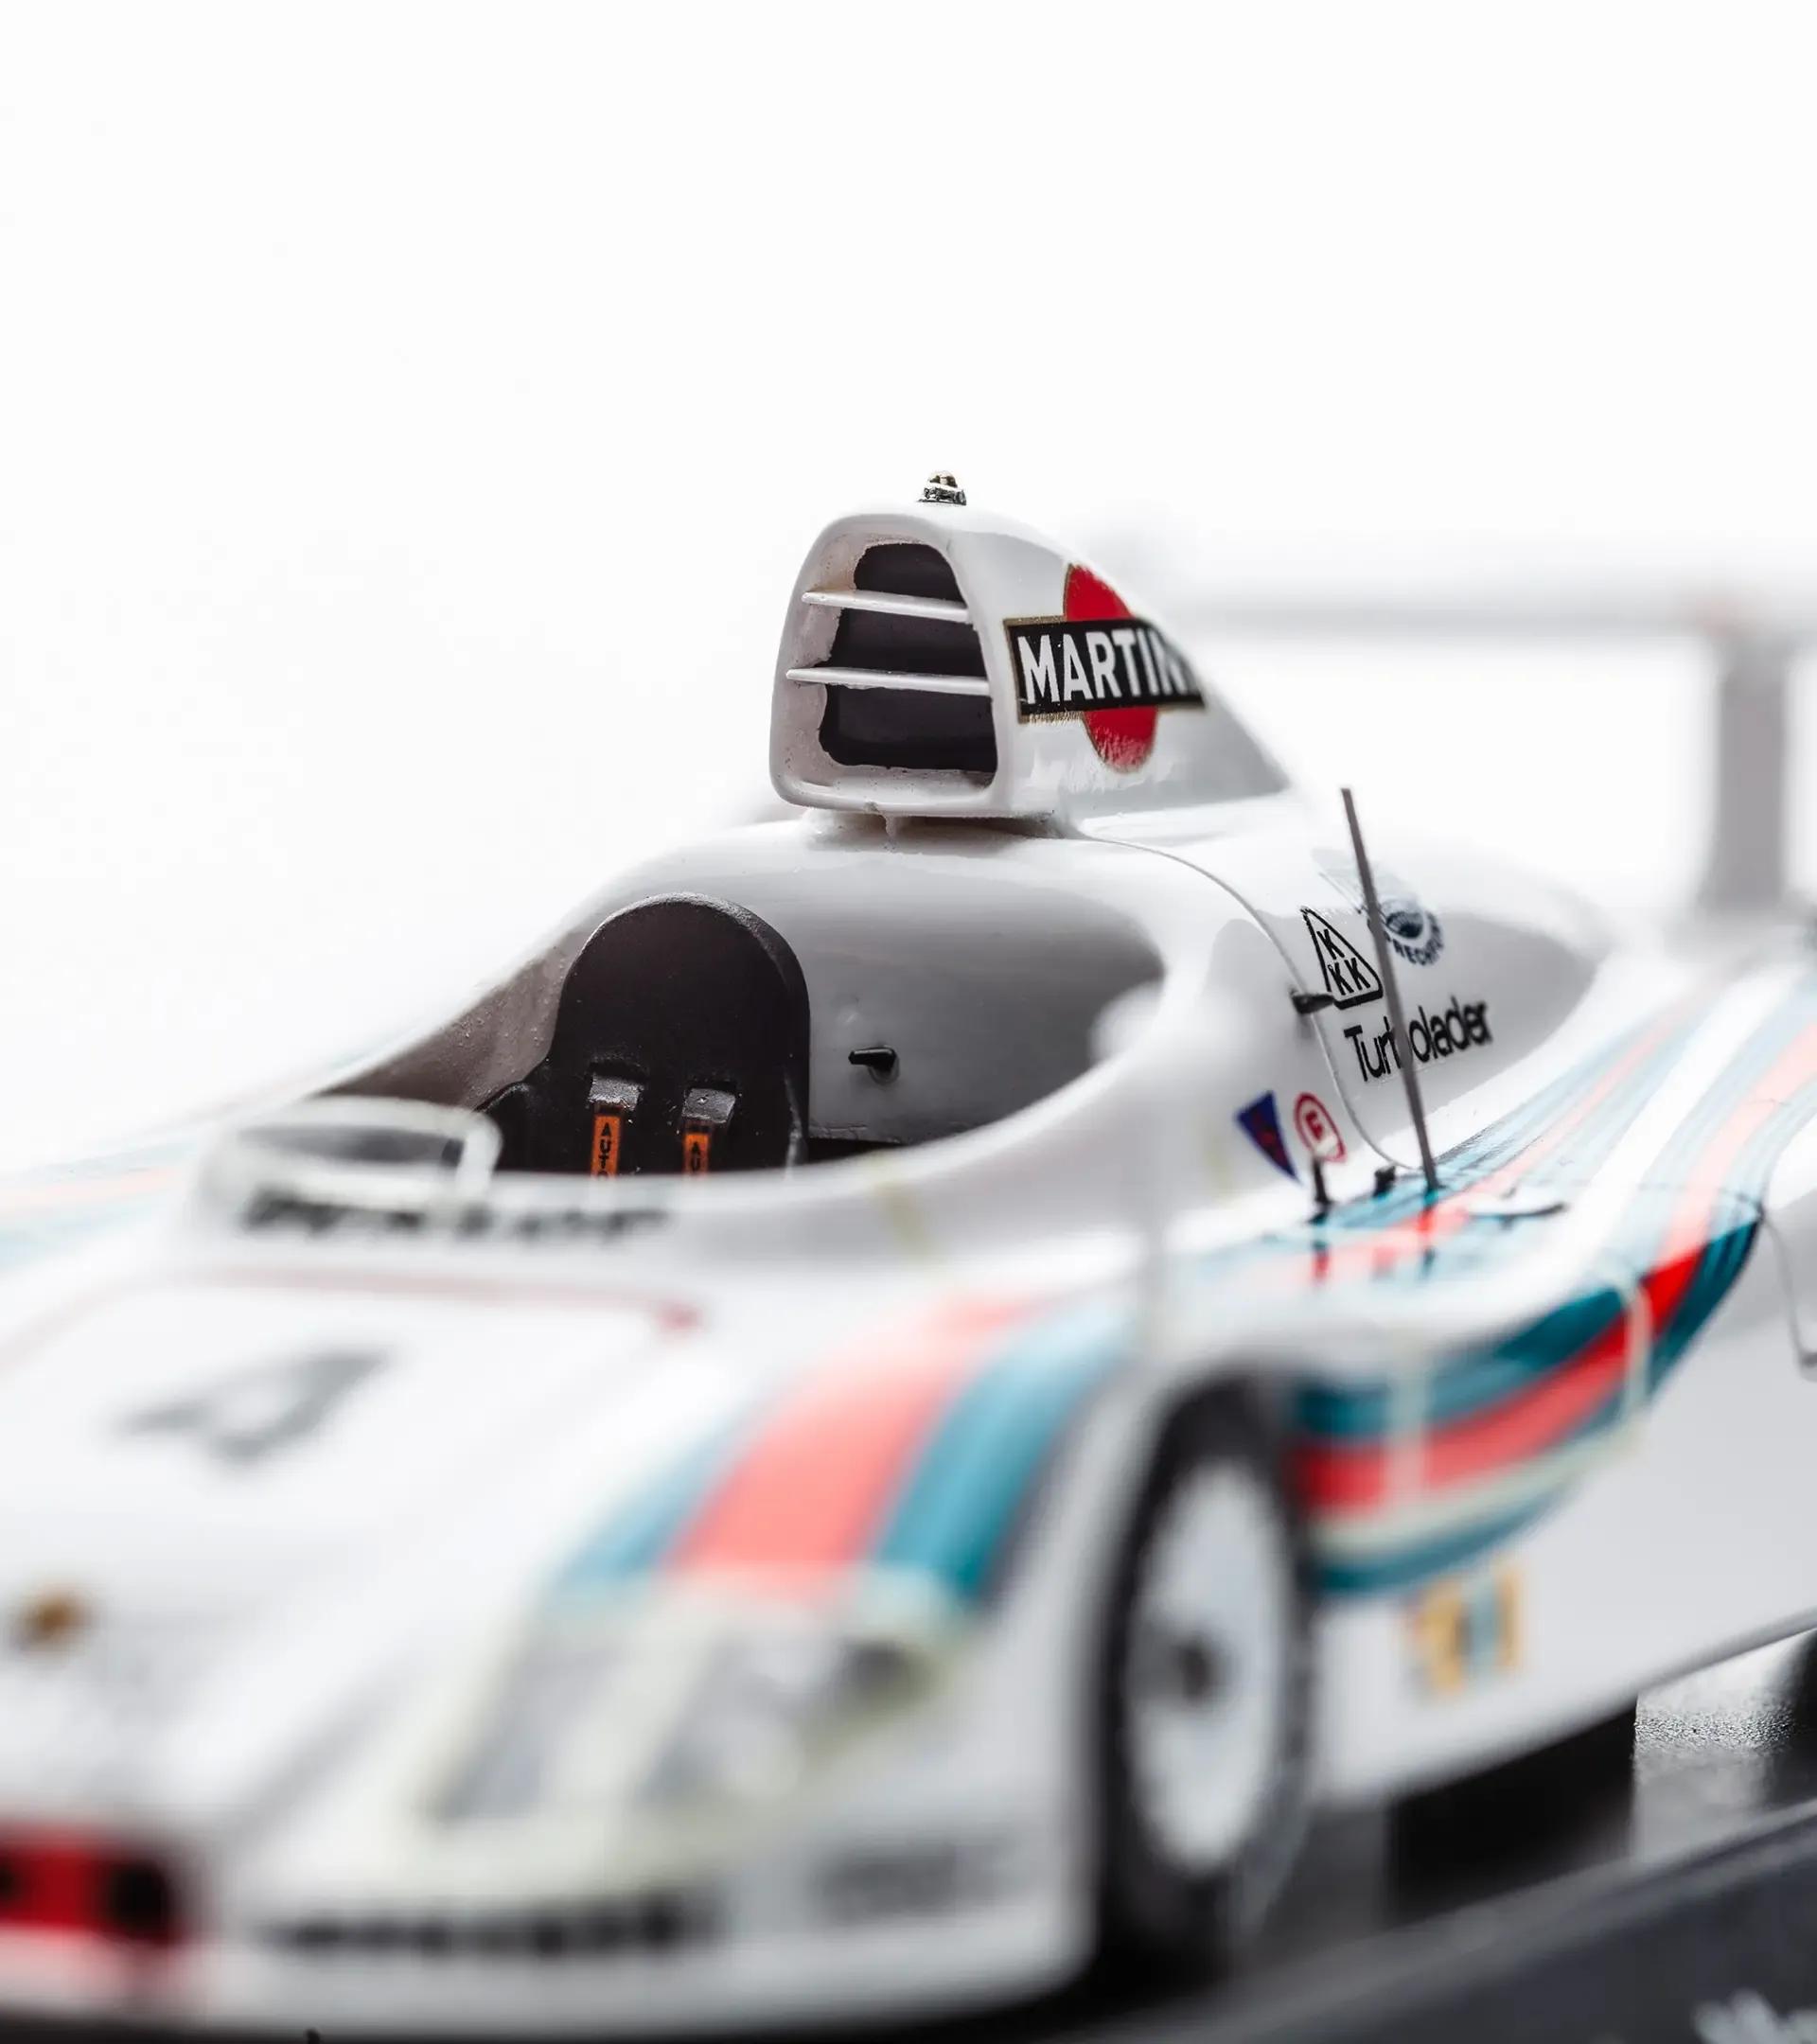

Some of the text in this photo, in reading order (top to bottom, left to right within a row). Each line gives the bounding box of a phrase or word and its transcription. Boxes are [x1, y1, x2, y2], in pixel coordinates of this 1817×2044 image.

[1017, 628, 1196, 704] MARTIN
[1316, 928, 1345, 960] K
[1328, 958, 1370, 995] KK
